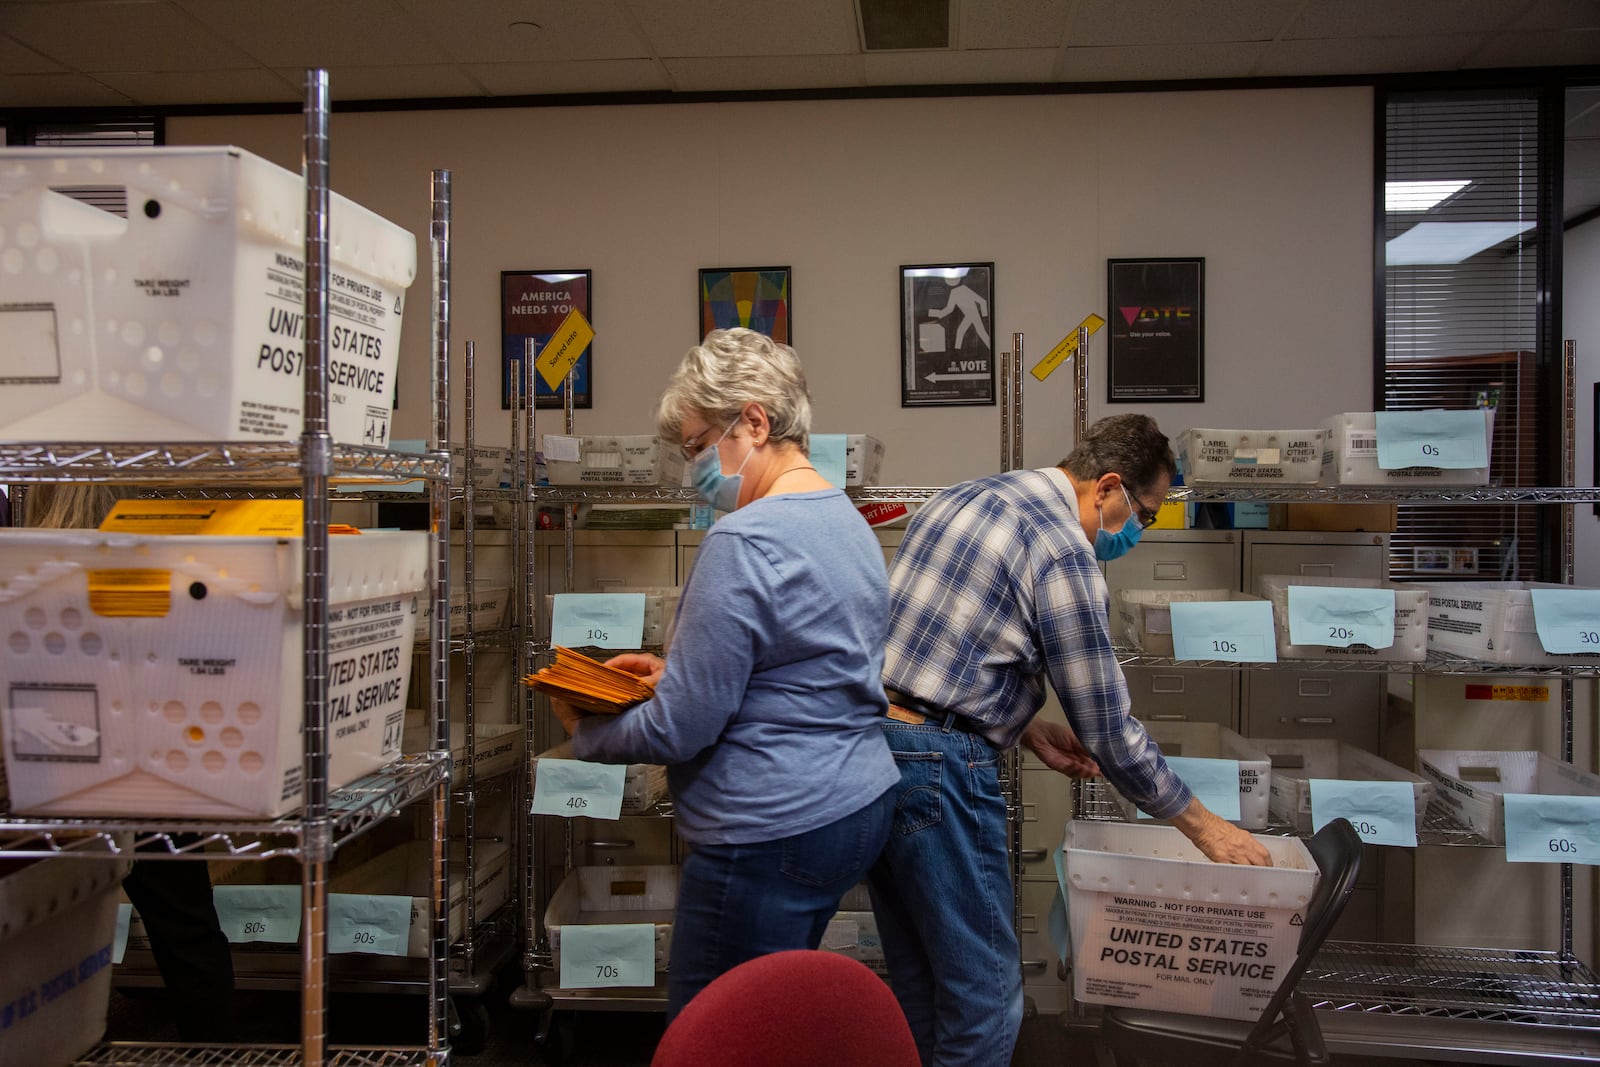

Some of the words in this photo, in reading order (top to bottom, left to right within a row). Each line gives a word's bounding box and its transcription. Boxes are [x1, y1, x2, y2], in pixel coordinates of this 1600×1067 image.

[275, 253, 304, 272] WARNI
[332, 273, 345, 288] FOR
[347, 279, 370, 297] PRIVATE
[371, 289, 382, 302] USE
[520, 291, 572, 302] AMERICA
[511, 305, 548, 315] NEEDS
[269, 307, 304, 341] UNIT
[332, 326, 382, 360] STATES
[548, 344, 569, 368] Sorted
[565, 330, 578, 346] into
[257, 344, 304, 378] POST
[329, 360, 385, 394] SERVICE
[959, 360, 987, 372] VOTE
[1202, 440, 1228, 448] LABEL
[1288, 441, 1314, 449] LABEL
[1201, 448, 1229, 456] OTHER
[1287, 449, 1315, 457] OTHER
[1206, 455, 1224, 463] END
[1387, 470, 1412, 478] POSTAL
[863, 509, 879, 521] ART
[878, 503, 904, 515] HERE
[328, 610, 343, 622] NING
[360, 606, 370, 617] FOR
[372, 602, 391, 615] PRIVATE
[392, 600, 401, 612] USE
[1442, 598, 1459, 609] POSTAL
[1461, 601, 1483, 611] SERVICE
[587, 629, 609, 641] 10s
[1329, 627, 1354, 639] 20s
[1580, 631, 1600, 644] 30
[1213, 640, 1237, 653] 10s
[178, 659, 201, 667] TARE
[203, 659, 236, 668] WEIGHT
[328, 659, 356, 688] ITED
[359, 646, 400, 680] STATES
[330, 694, 351, 722] TAL
[355, 677, 402, 713] SERVICE
[1239, 769, 1258, 777] BEL
[566, 796, 588, 809] 40s
[1352, 822, 1377, 835] 50s
[1548, 838, 1577, 853] 60s
[1114, 897, 1157, 909] WARNING
[1164, 903, 1183, 911] NOT
[1185, 905, 1205, 914] FOR
[1207, 907, 1245, 918] PRIVATE
[1247, 911, 1266, 919] USE
[244, 922, 266, 934] 80s
[1223, 920, 1242, 928] POSTAL
[1244, 922, 1273, 931] PROPERTY
[353, 932, 376, 945] 90s
[1110, 927, 1182, 950] UNITED
[1188, 936, 1268, 958] STATES
[1100, 947, 1180, 970] POSTAL
[1187, 958, 1276, 980] SERVICE
[595, 965, 618, 979] 70s
[1156, 974, 1172, 982] FOR
[1173, 975, 1192, 984] MAIL
[1193, 977, 1215, 987] ONLY
